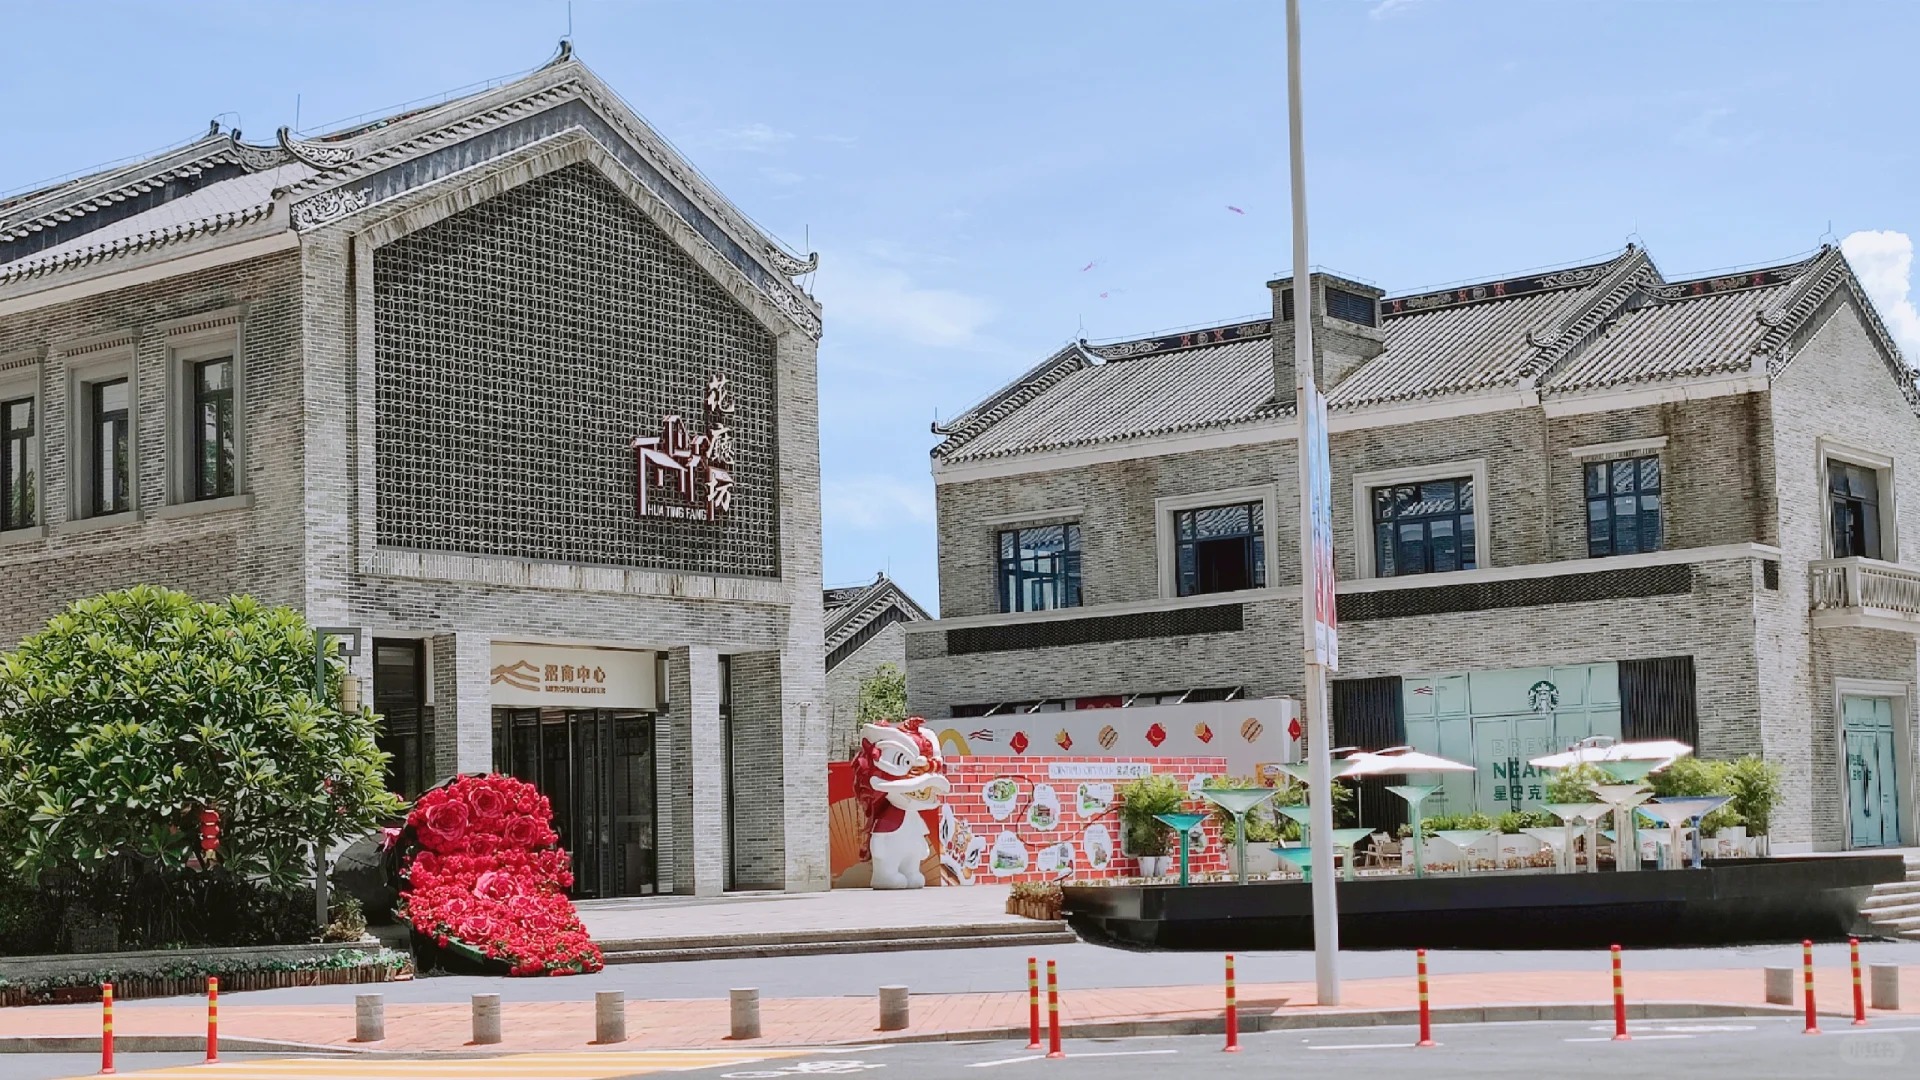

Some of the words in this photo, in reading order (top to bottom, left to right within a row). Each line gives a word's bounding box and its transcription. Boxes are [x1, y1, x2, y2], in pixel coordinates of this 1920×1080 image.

[647, 503, 664, 517] HUA
[666, 505, 685, 519] TING
[686, 507, 708, 521] FANG
[581, 686, 606, 694] CENTER
